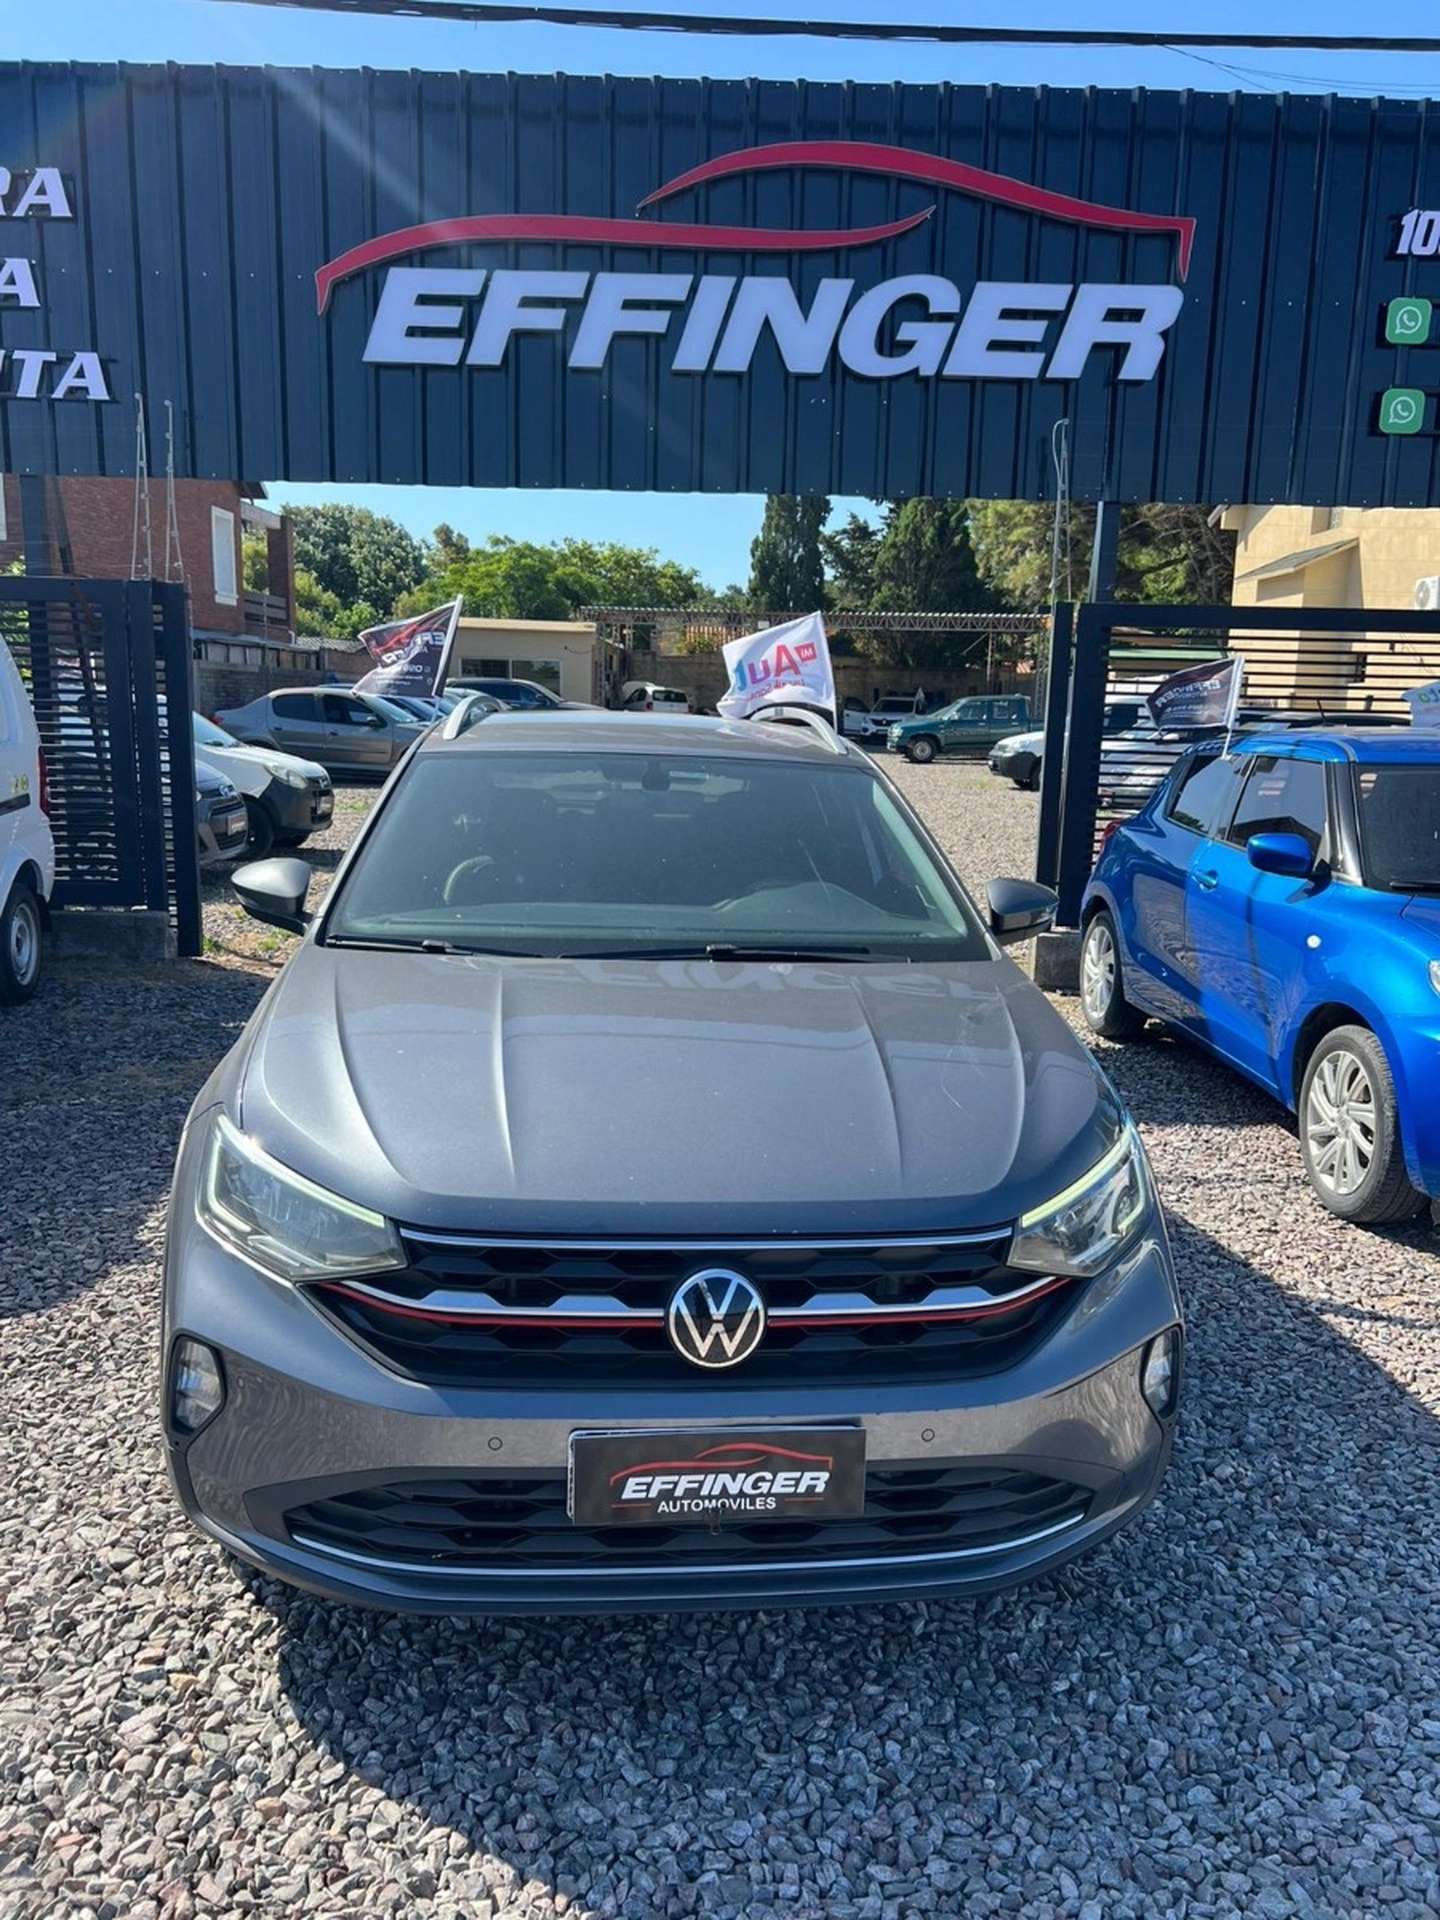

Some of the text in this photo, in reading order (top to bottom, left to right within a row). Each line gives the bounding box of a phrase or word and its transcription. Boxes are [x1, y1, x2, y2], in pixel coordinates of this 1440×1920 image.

[362, 267, 1184, 381] EFFINGER
[620, 1471, 830, 1500] EFFINGER
[657, 1497, 776, 1513] AUTOMOVILES
